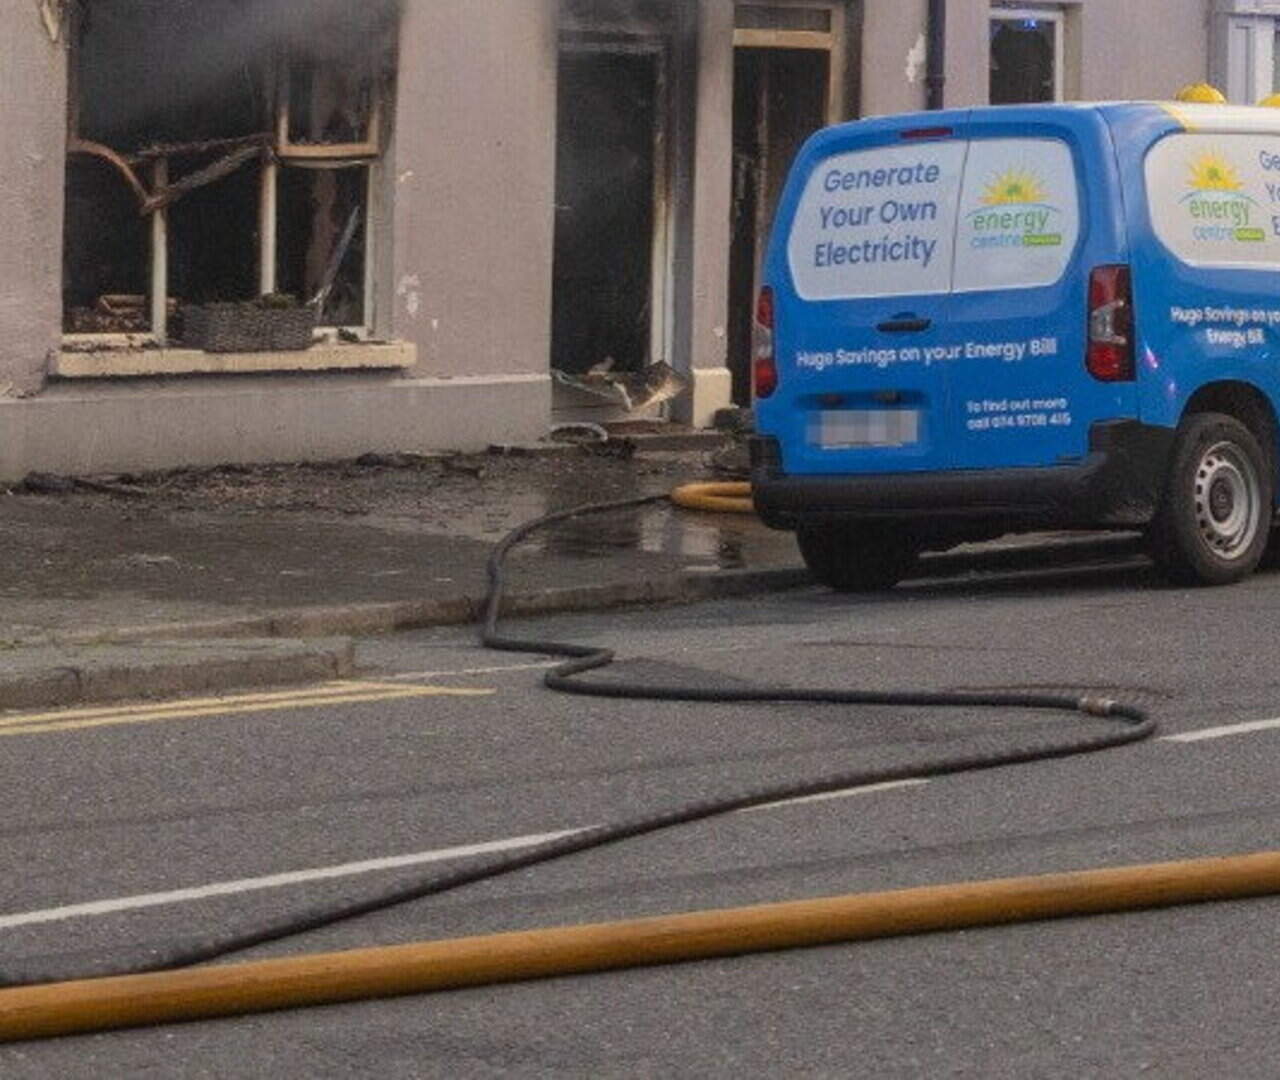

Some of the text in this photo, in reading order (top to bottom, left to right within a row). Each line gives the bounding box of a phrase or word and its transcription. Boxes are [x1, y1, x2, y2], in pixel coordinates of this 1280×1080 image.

[824, 163, 940, 192] Generate
[819, 200, 937, 230] Your Own
[973, 209, 1050, 235] energy
[1189, 199, 1250, 226] energy
[814, 236, 937, 268] Electricity
[970, 233, 1023, 249] centre
[1170, 306, 1203, 326] Huge
[1204, 305, 1249, 327] Savings
[796, 337, 1057, 370] Huge Savings on your Energy Bill
[966, 398, 1067, 413] To find out more
